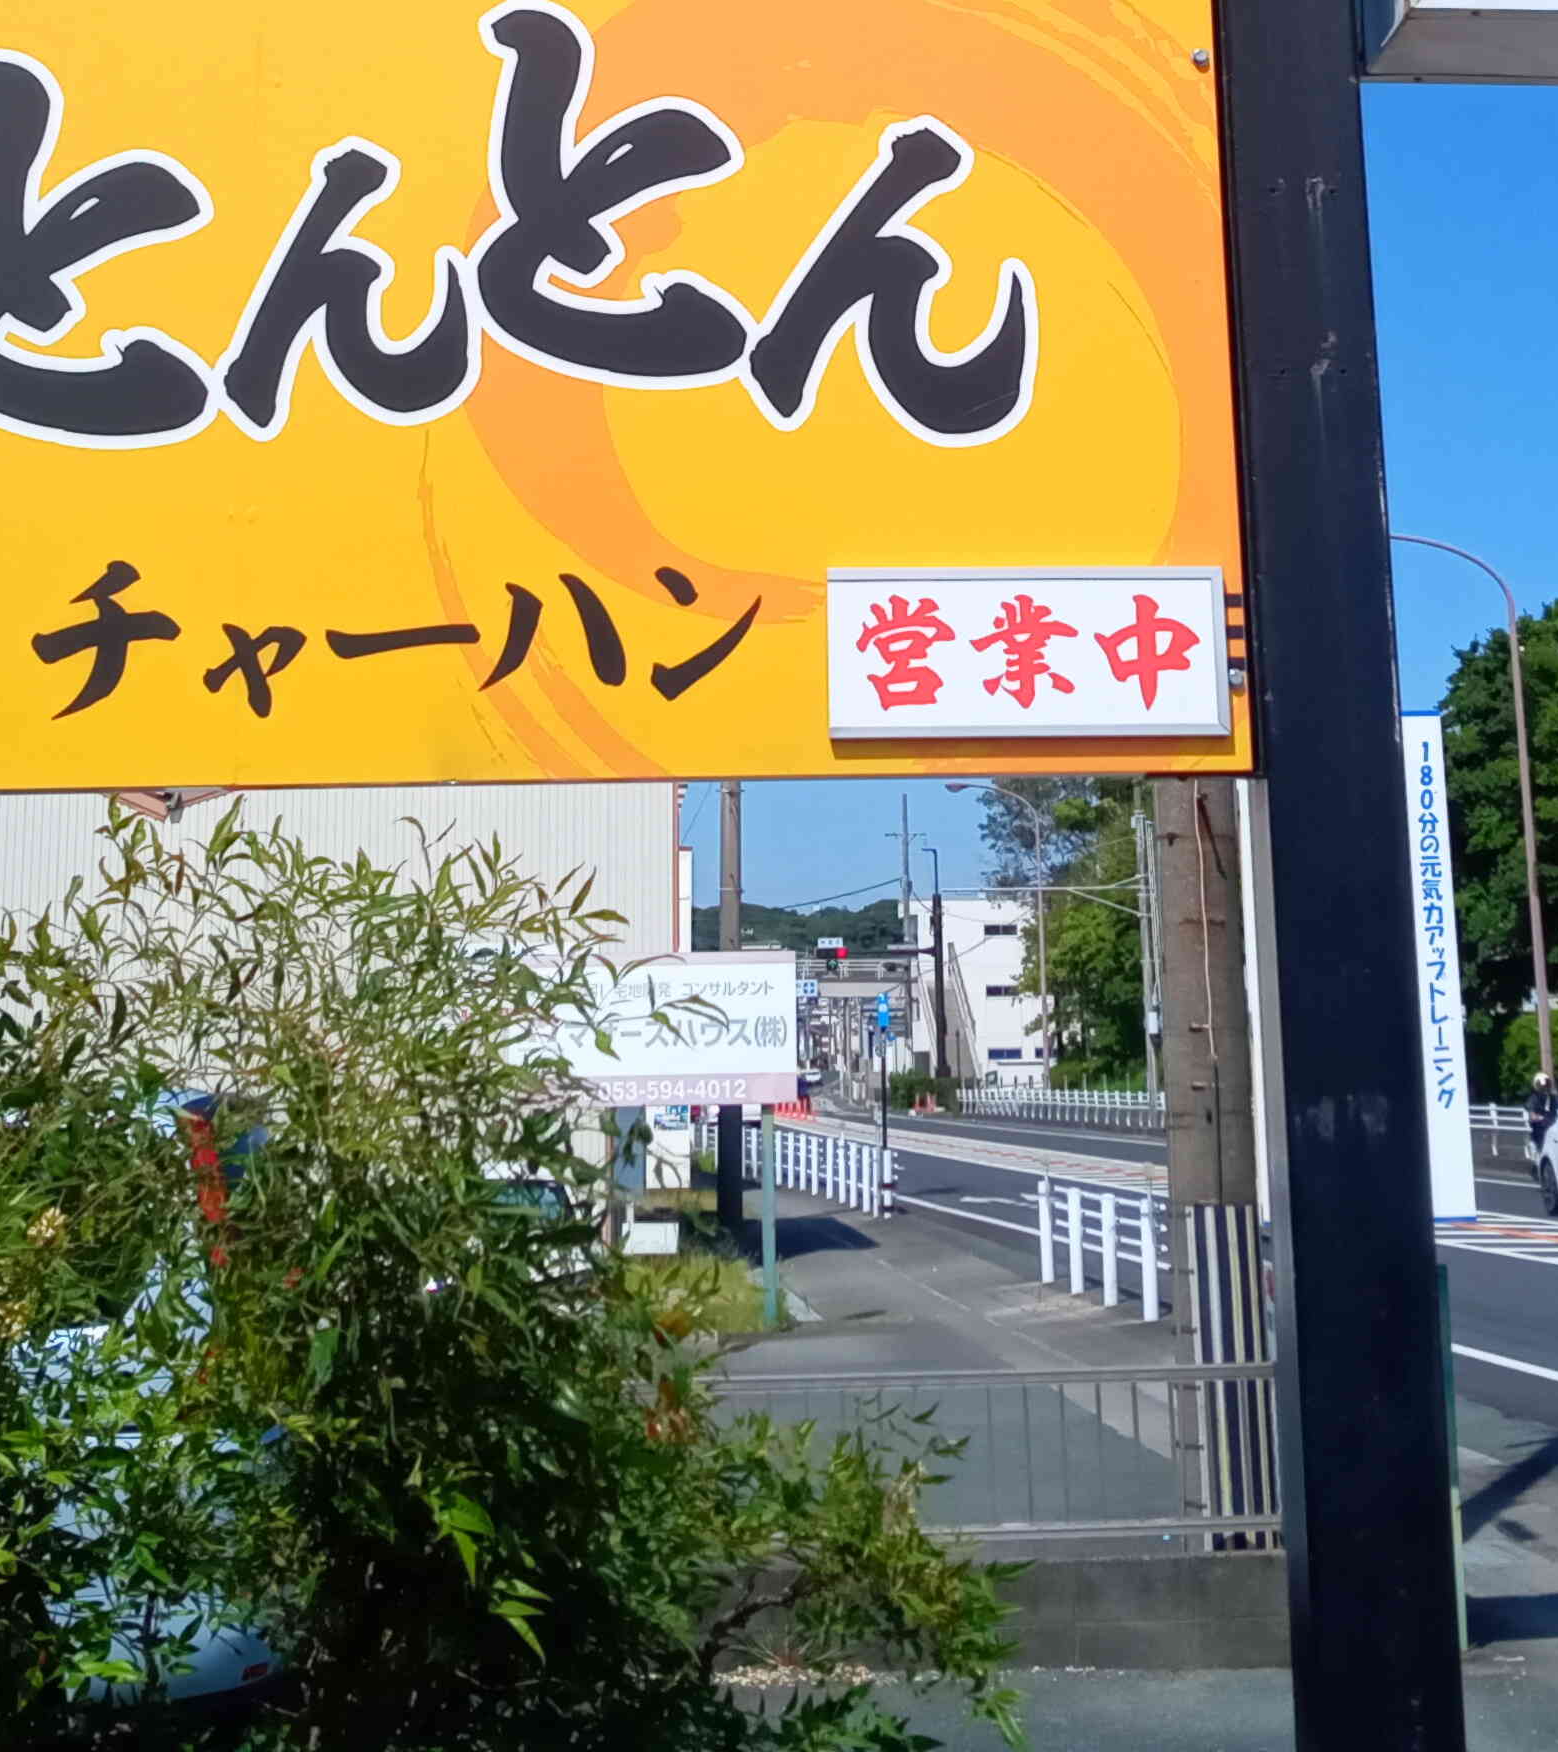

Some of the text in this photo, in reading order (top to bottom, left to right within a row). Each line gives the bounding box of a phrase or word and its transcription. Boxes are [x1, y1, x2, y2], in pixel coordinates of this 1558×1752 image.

[856, 593, 1201, 712] 営業中
[682, 979, 775, 998] コンサルタント
